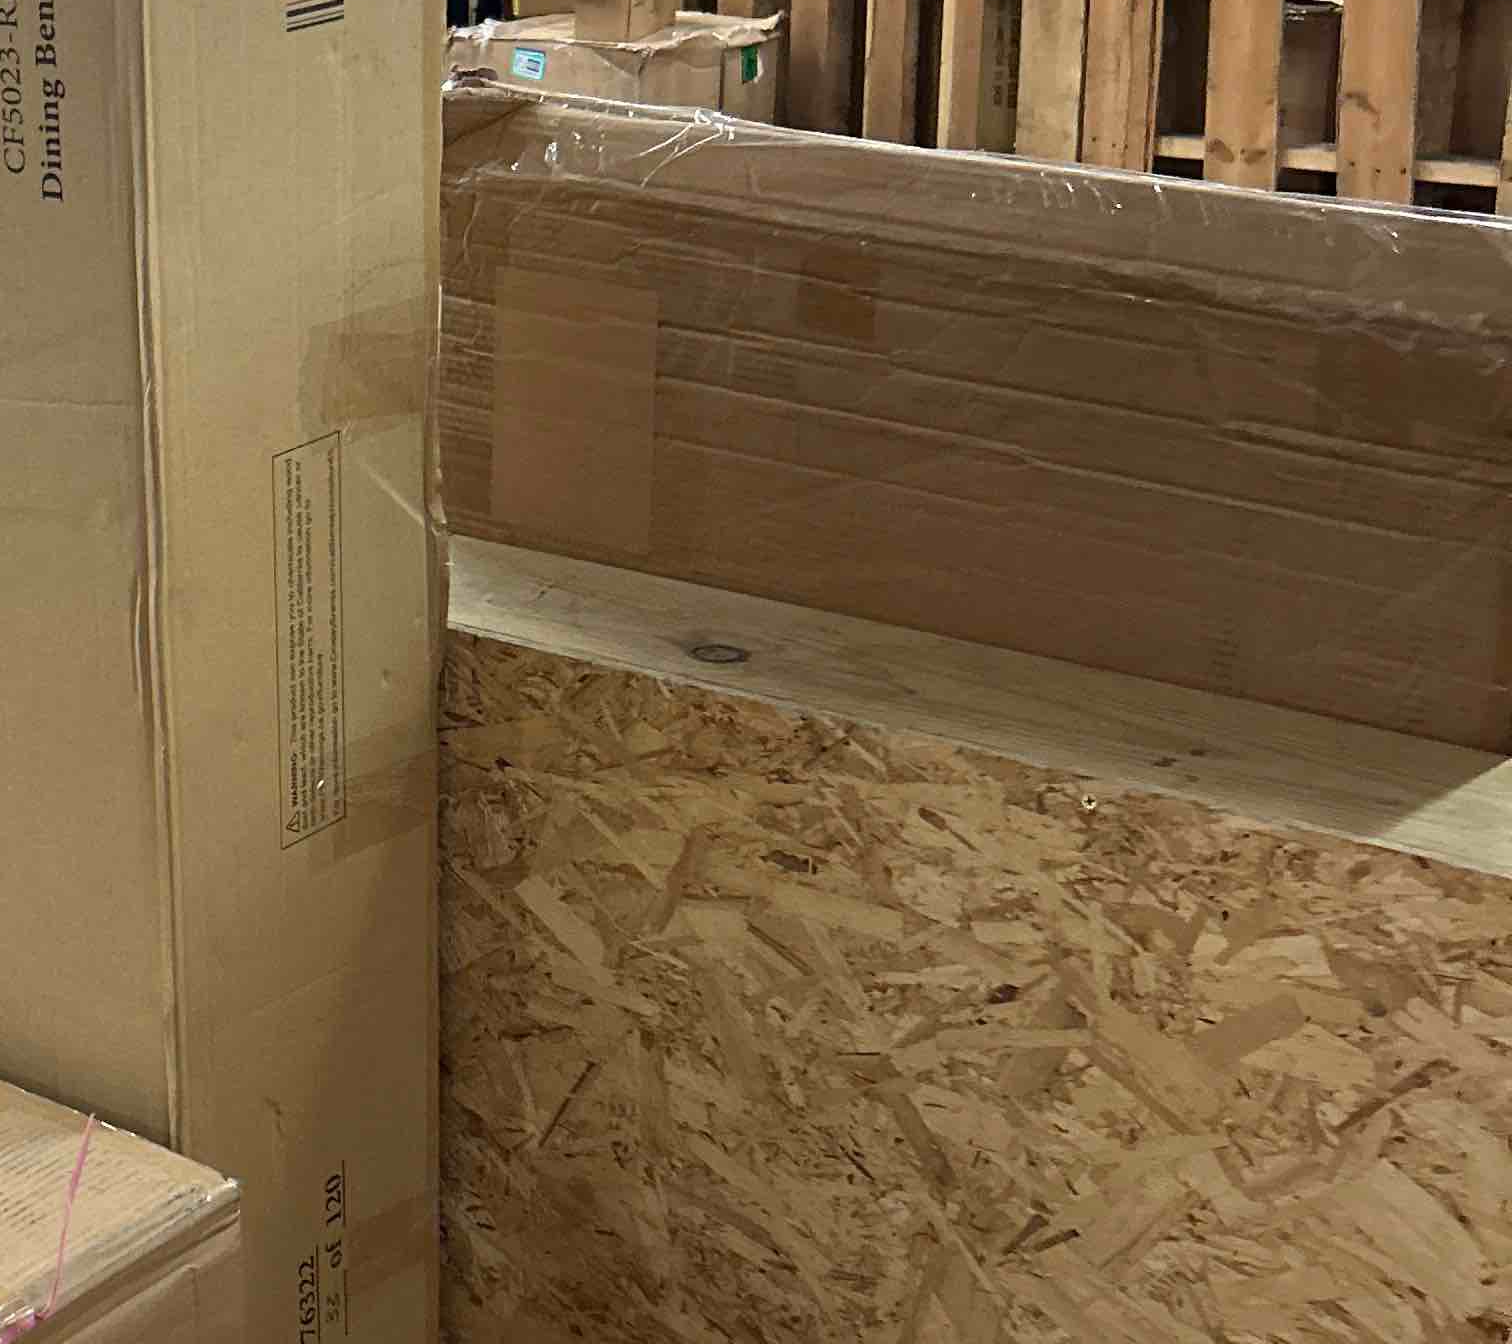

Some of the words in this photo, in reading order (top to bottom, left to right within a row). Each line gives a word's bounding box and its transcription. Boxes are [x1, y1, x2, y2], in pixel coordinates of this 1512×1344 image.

[38, 78, 65, 201] Dining
[325, 1174, 342, 1225] 120
[326, 1238, 342, 1269] of
[298, 1256, 316, 1344] 76322
